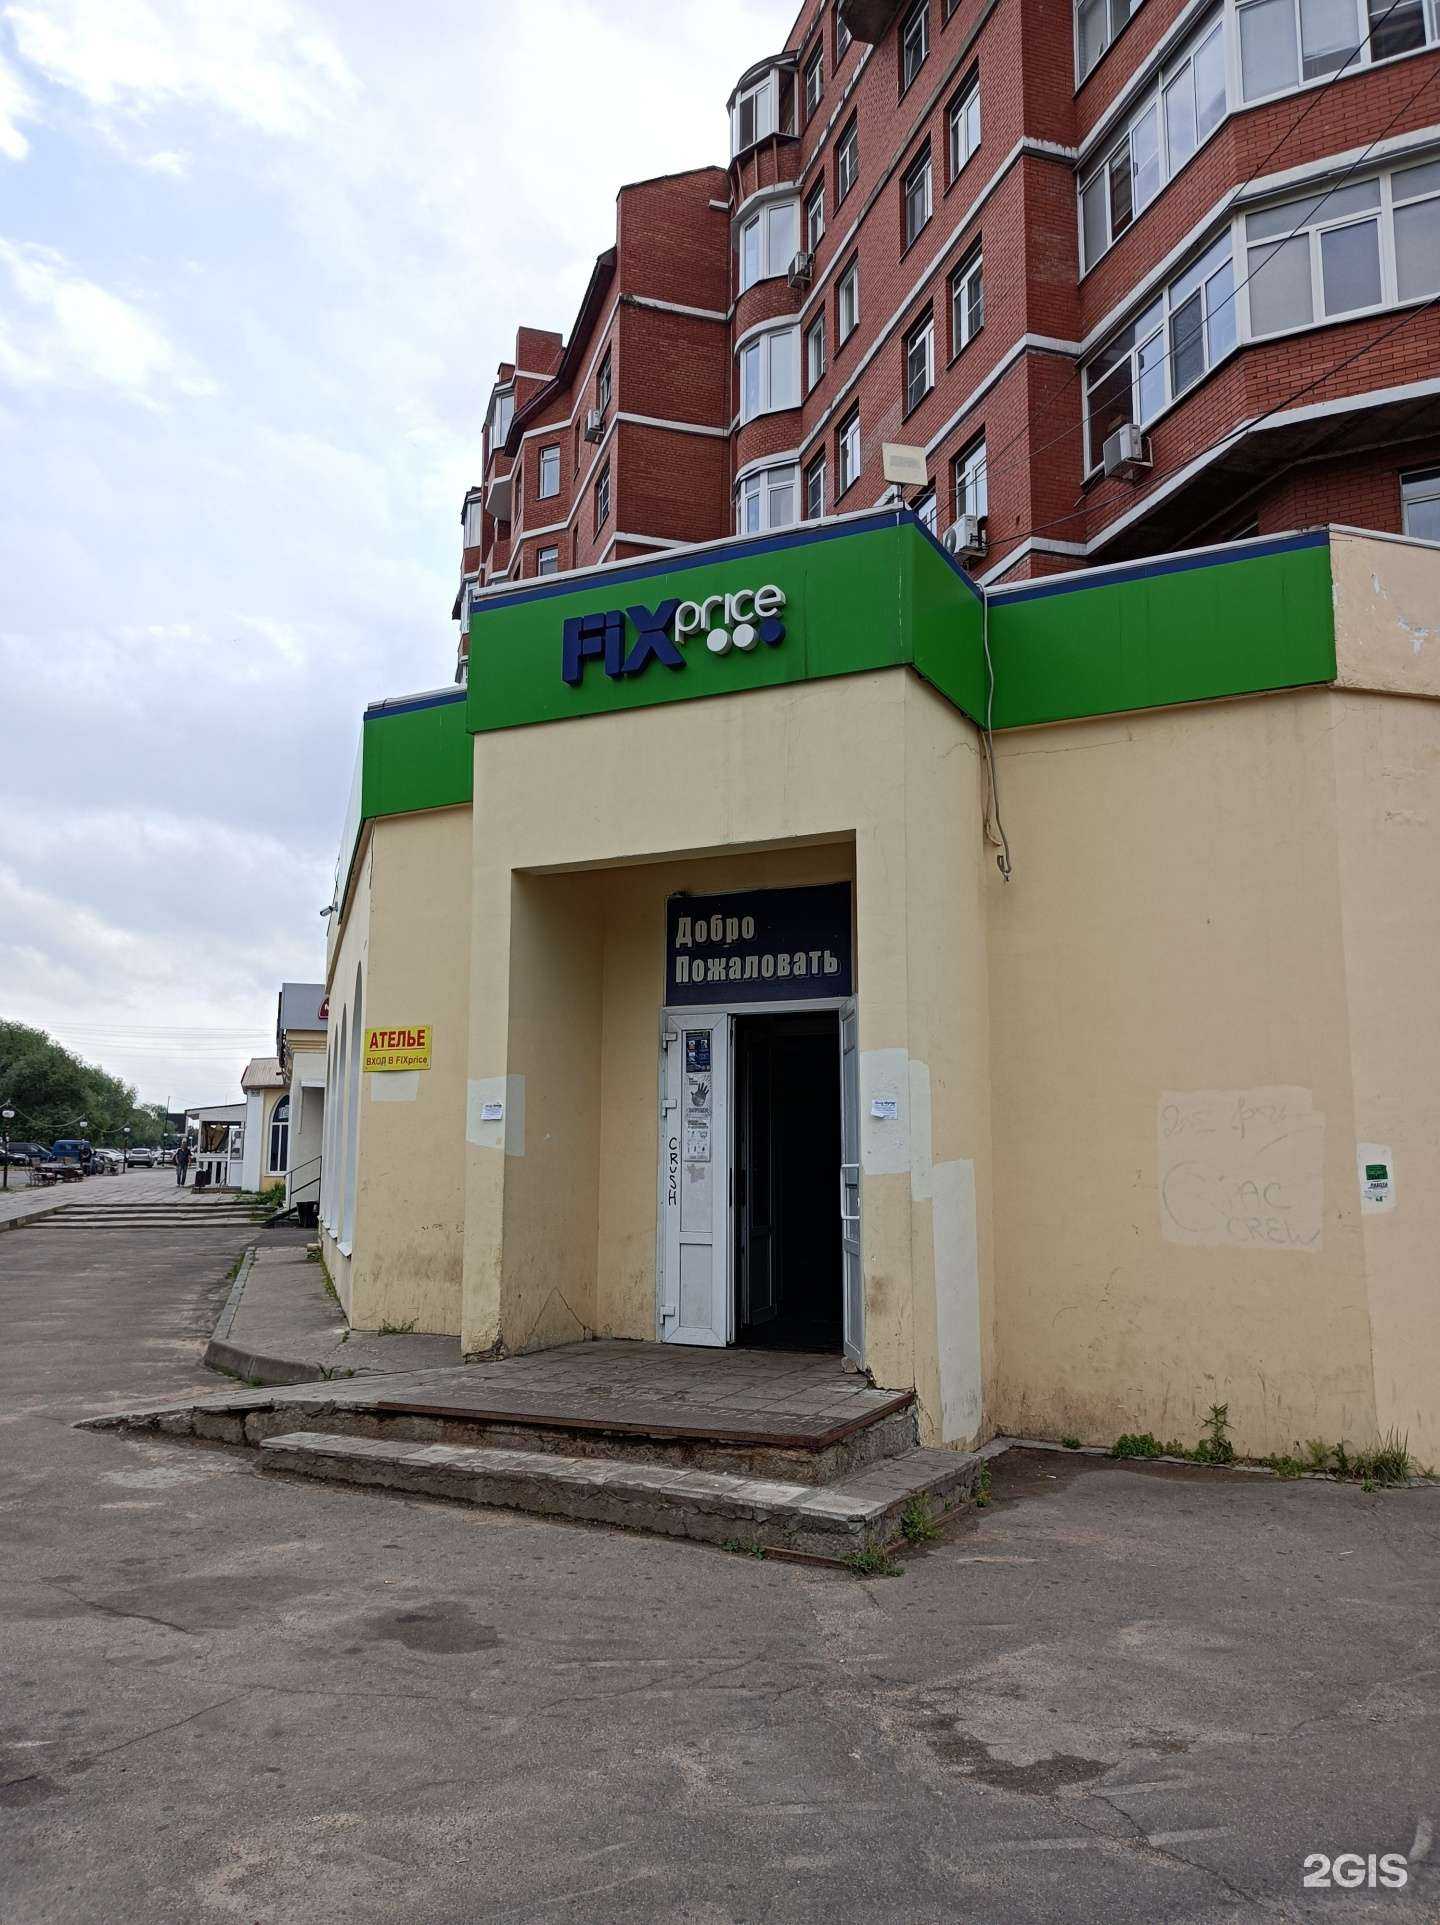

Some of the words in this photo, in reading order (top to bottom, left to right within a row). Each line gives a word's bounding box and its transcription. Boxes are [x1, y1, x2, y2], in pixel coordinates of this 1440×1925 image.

[675, 585, 786, 644] price
[675, 914, 756, 948] Добро
[675, 950, 840, 984] Пожаловать
[369, 1030, 426, 1048] АТЕЛЬЕ
[366, 1057, 386, 1067] ВХОД
[388, 1056, 394, 1065] В
[668, 1136, 679, 1206] CRUSH
